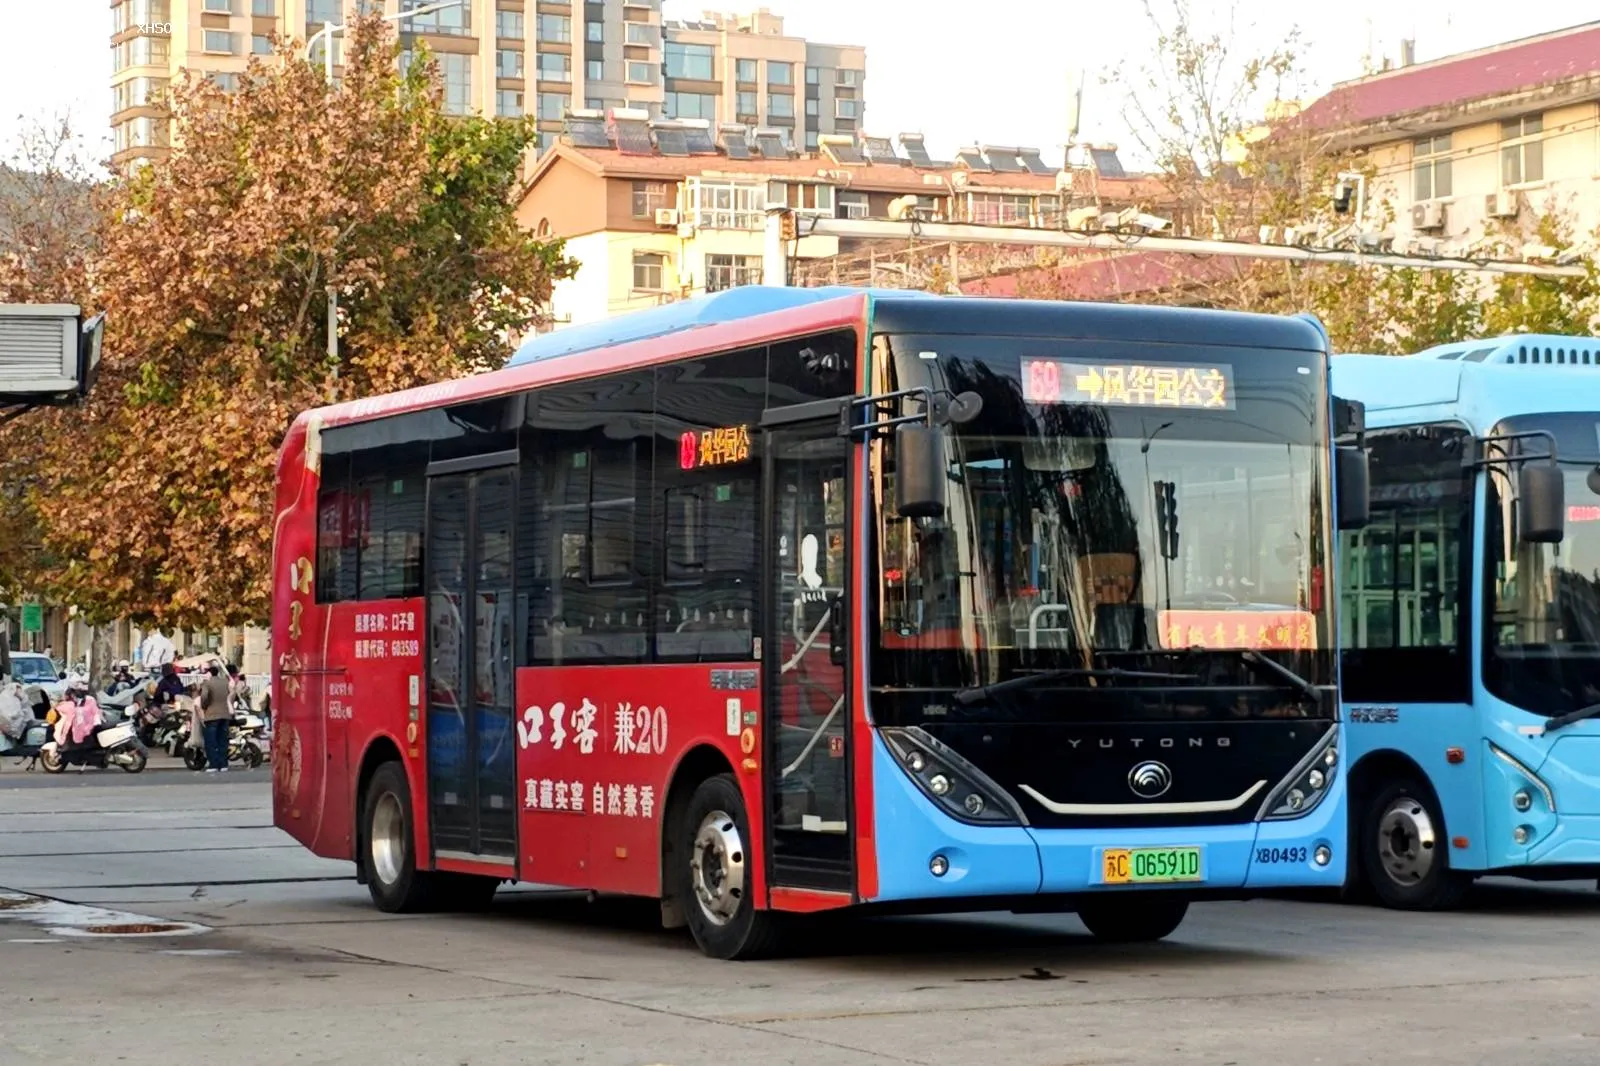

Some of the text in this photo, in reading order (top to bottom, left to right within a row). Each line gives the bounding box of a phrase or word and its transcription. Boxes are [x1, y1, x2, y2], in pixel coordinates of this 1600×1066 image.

[1103, 365, 1227, 408] 风华园公交
[1068, 736, 1231, 749] YUTONG
[592, 781, 654, 818] 自然兼香
[1255, 846, 1307, 863] XB0493
